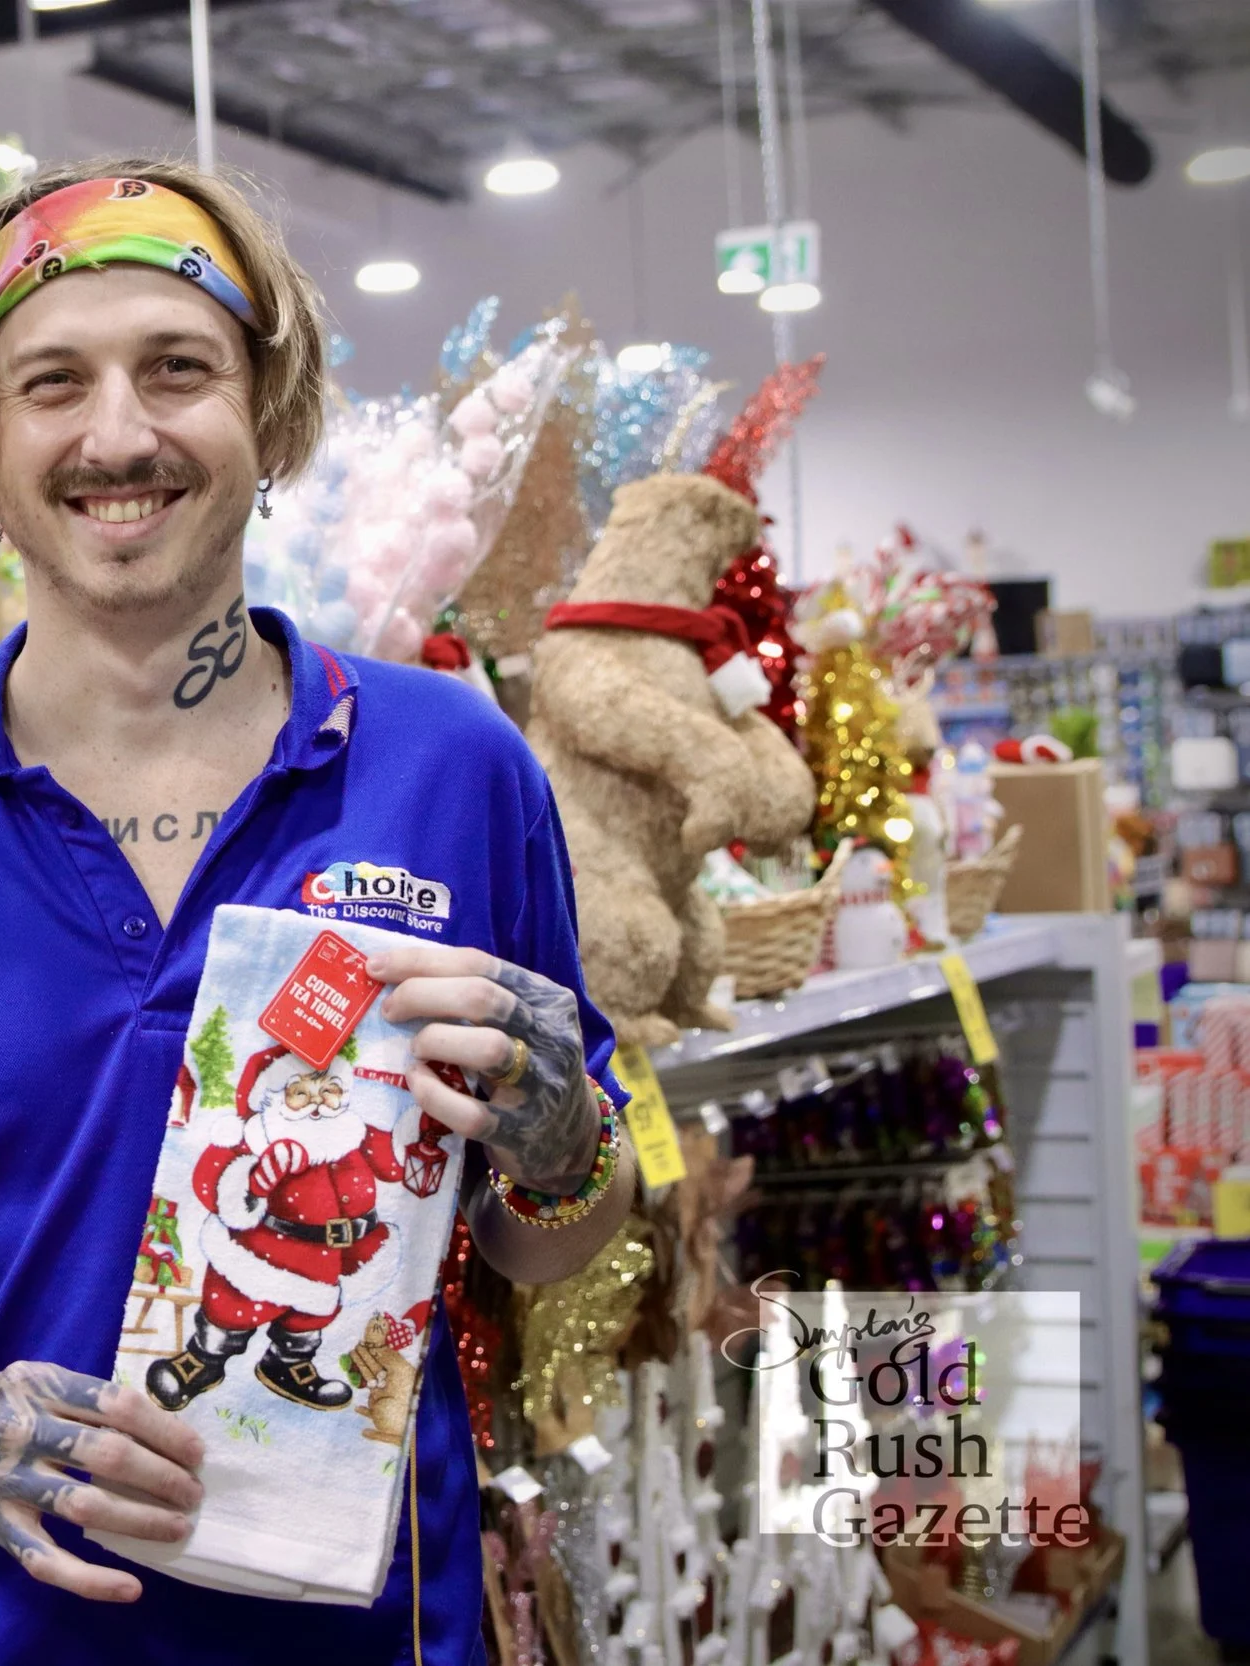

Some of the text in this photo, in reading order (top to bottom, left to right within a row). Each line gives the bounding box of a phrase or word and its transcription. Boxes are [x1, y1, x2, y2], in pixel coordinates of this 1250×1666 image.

[307, 903, 443, 933] The Discount Store
[289, 981, 347, 1032] TEA TOWEL
[305, 974, 351, 1012] COTTON
